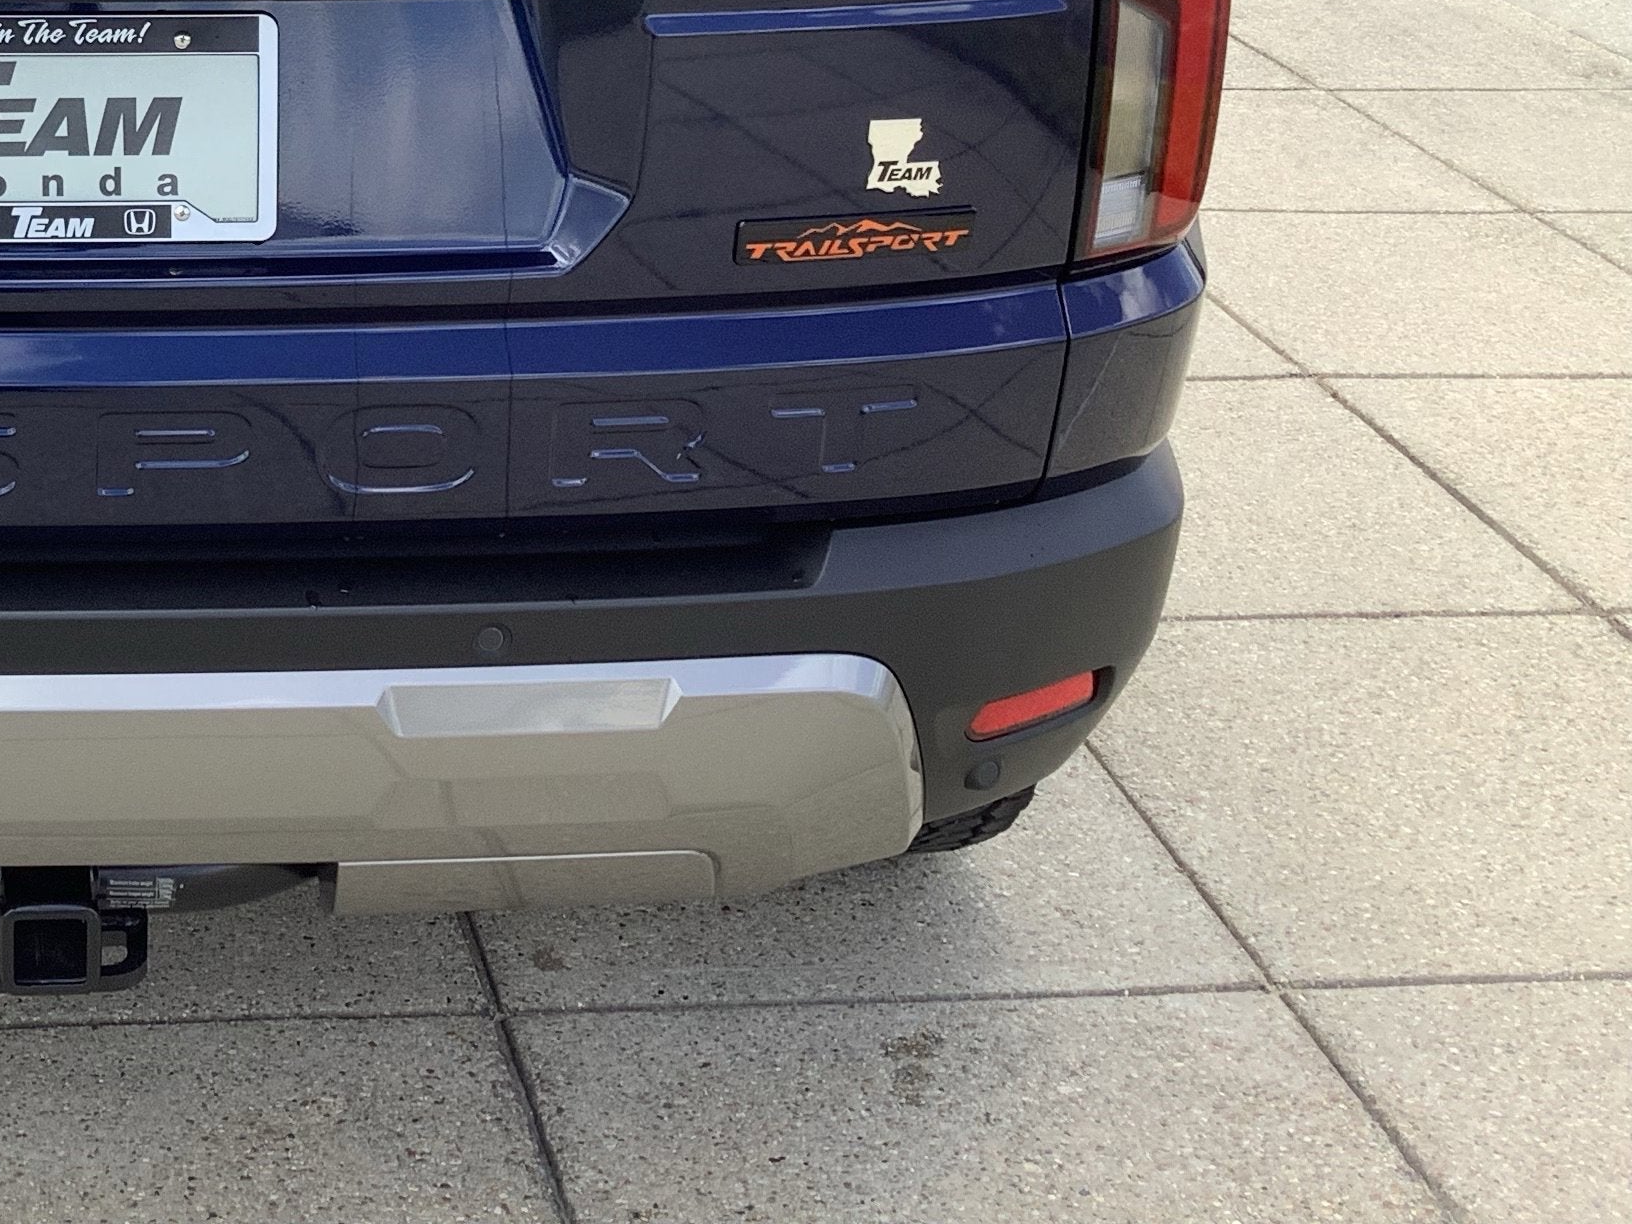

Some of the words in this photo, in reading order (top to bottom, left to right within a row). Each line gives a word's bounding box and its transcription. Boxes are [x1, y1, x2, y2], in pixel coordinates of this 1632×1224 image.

[17, 18, 67, 46] The
[68, 18, 152, 46] Team!
[877, 160, 933, 182] TEAM
[12, 207, 94, 238] TEAM
[746, 229, 970, 262] TRAILSPORT
